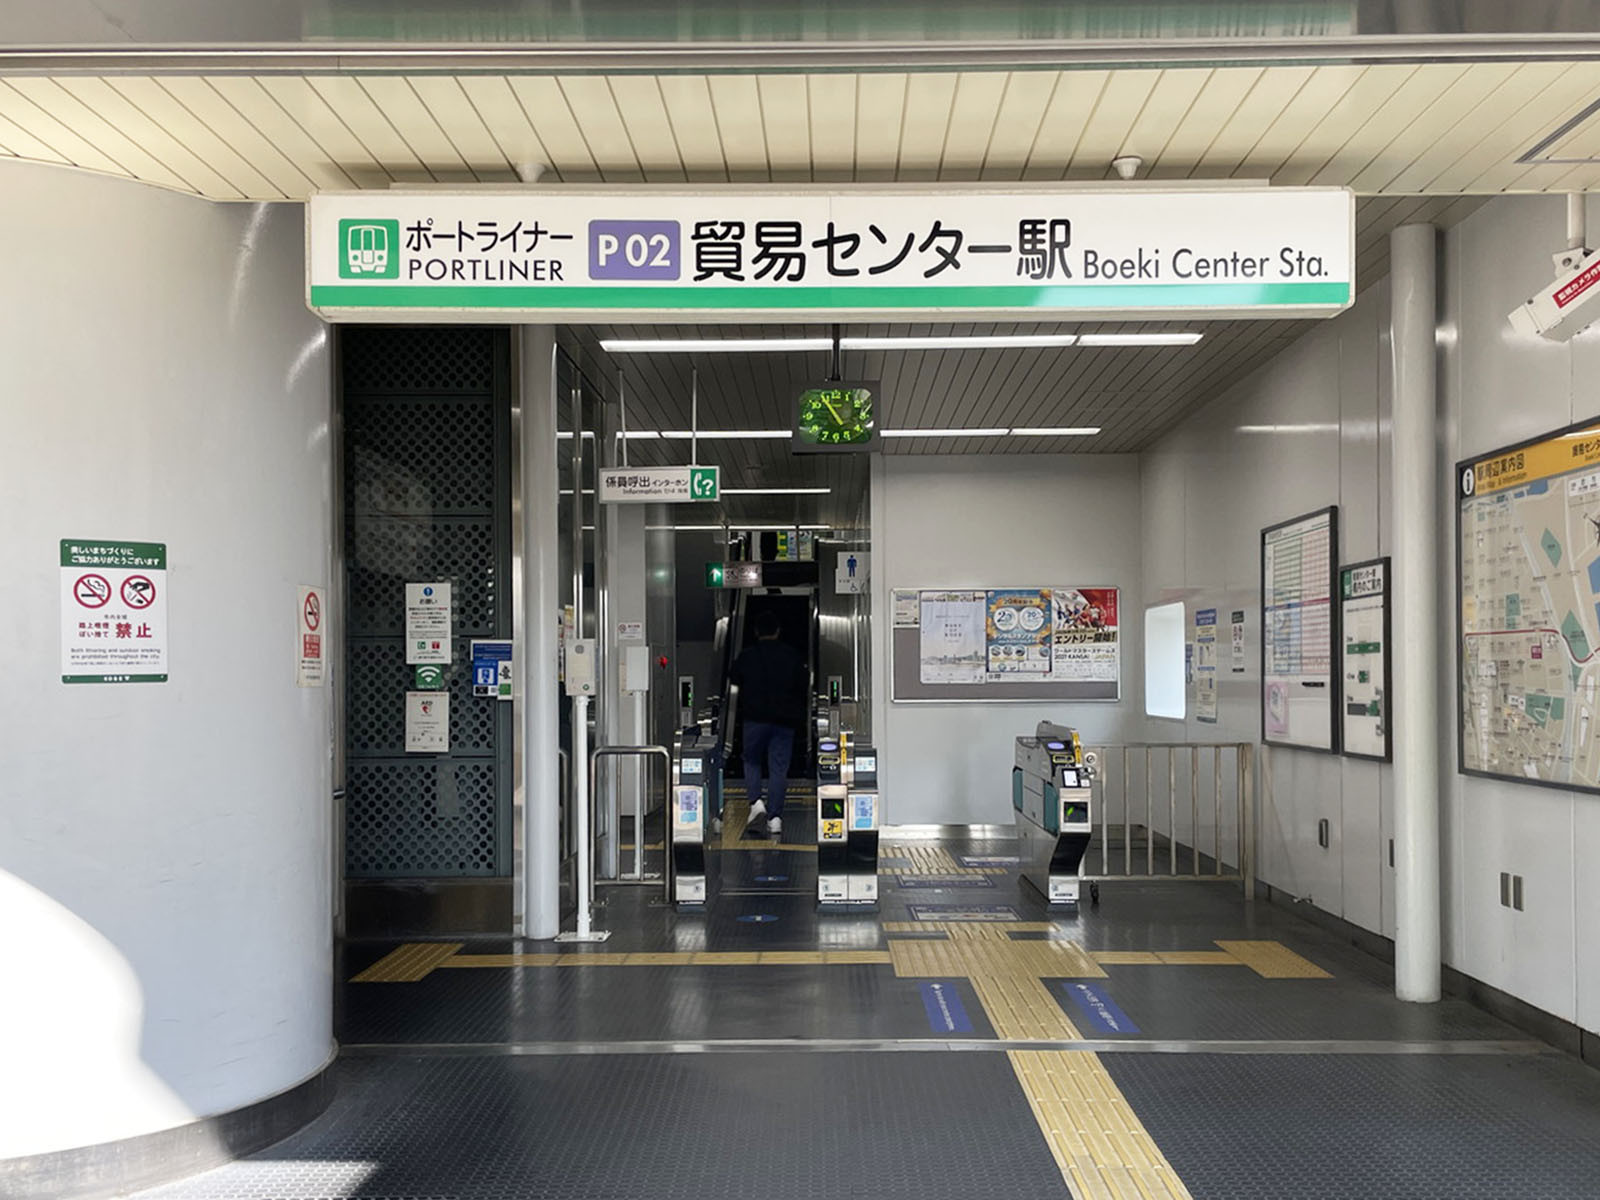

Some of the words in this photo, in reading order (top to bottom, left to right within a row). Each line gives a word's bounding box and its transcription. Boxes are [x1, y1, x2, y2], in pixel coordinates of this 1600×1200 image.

[405, 218, 574, 253] ポートライナー
[690, 218, 1072, 283] 貿易センター駅
[408, 259, 564, 281] PORTLINER
[1083, 249, 1160, 279] Boeki
[1172, 249, 1269, 278] Center
[1279, 247, 1329, 277] Sta.
[115, 622, 152, 639] 禁止
